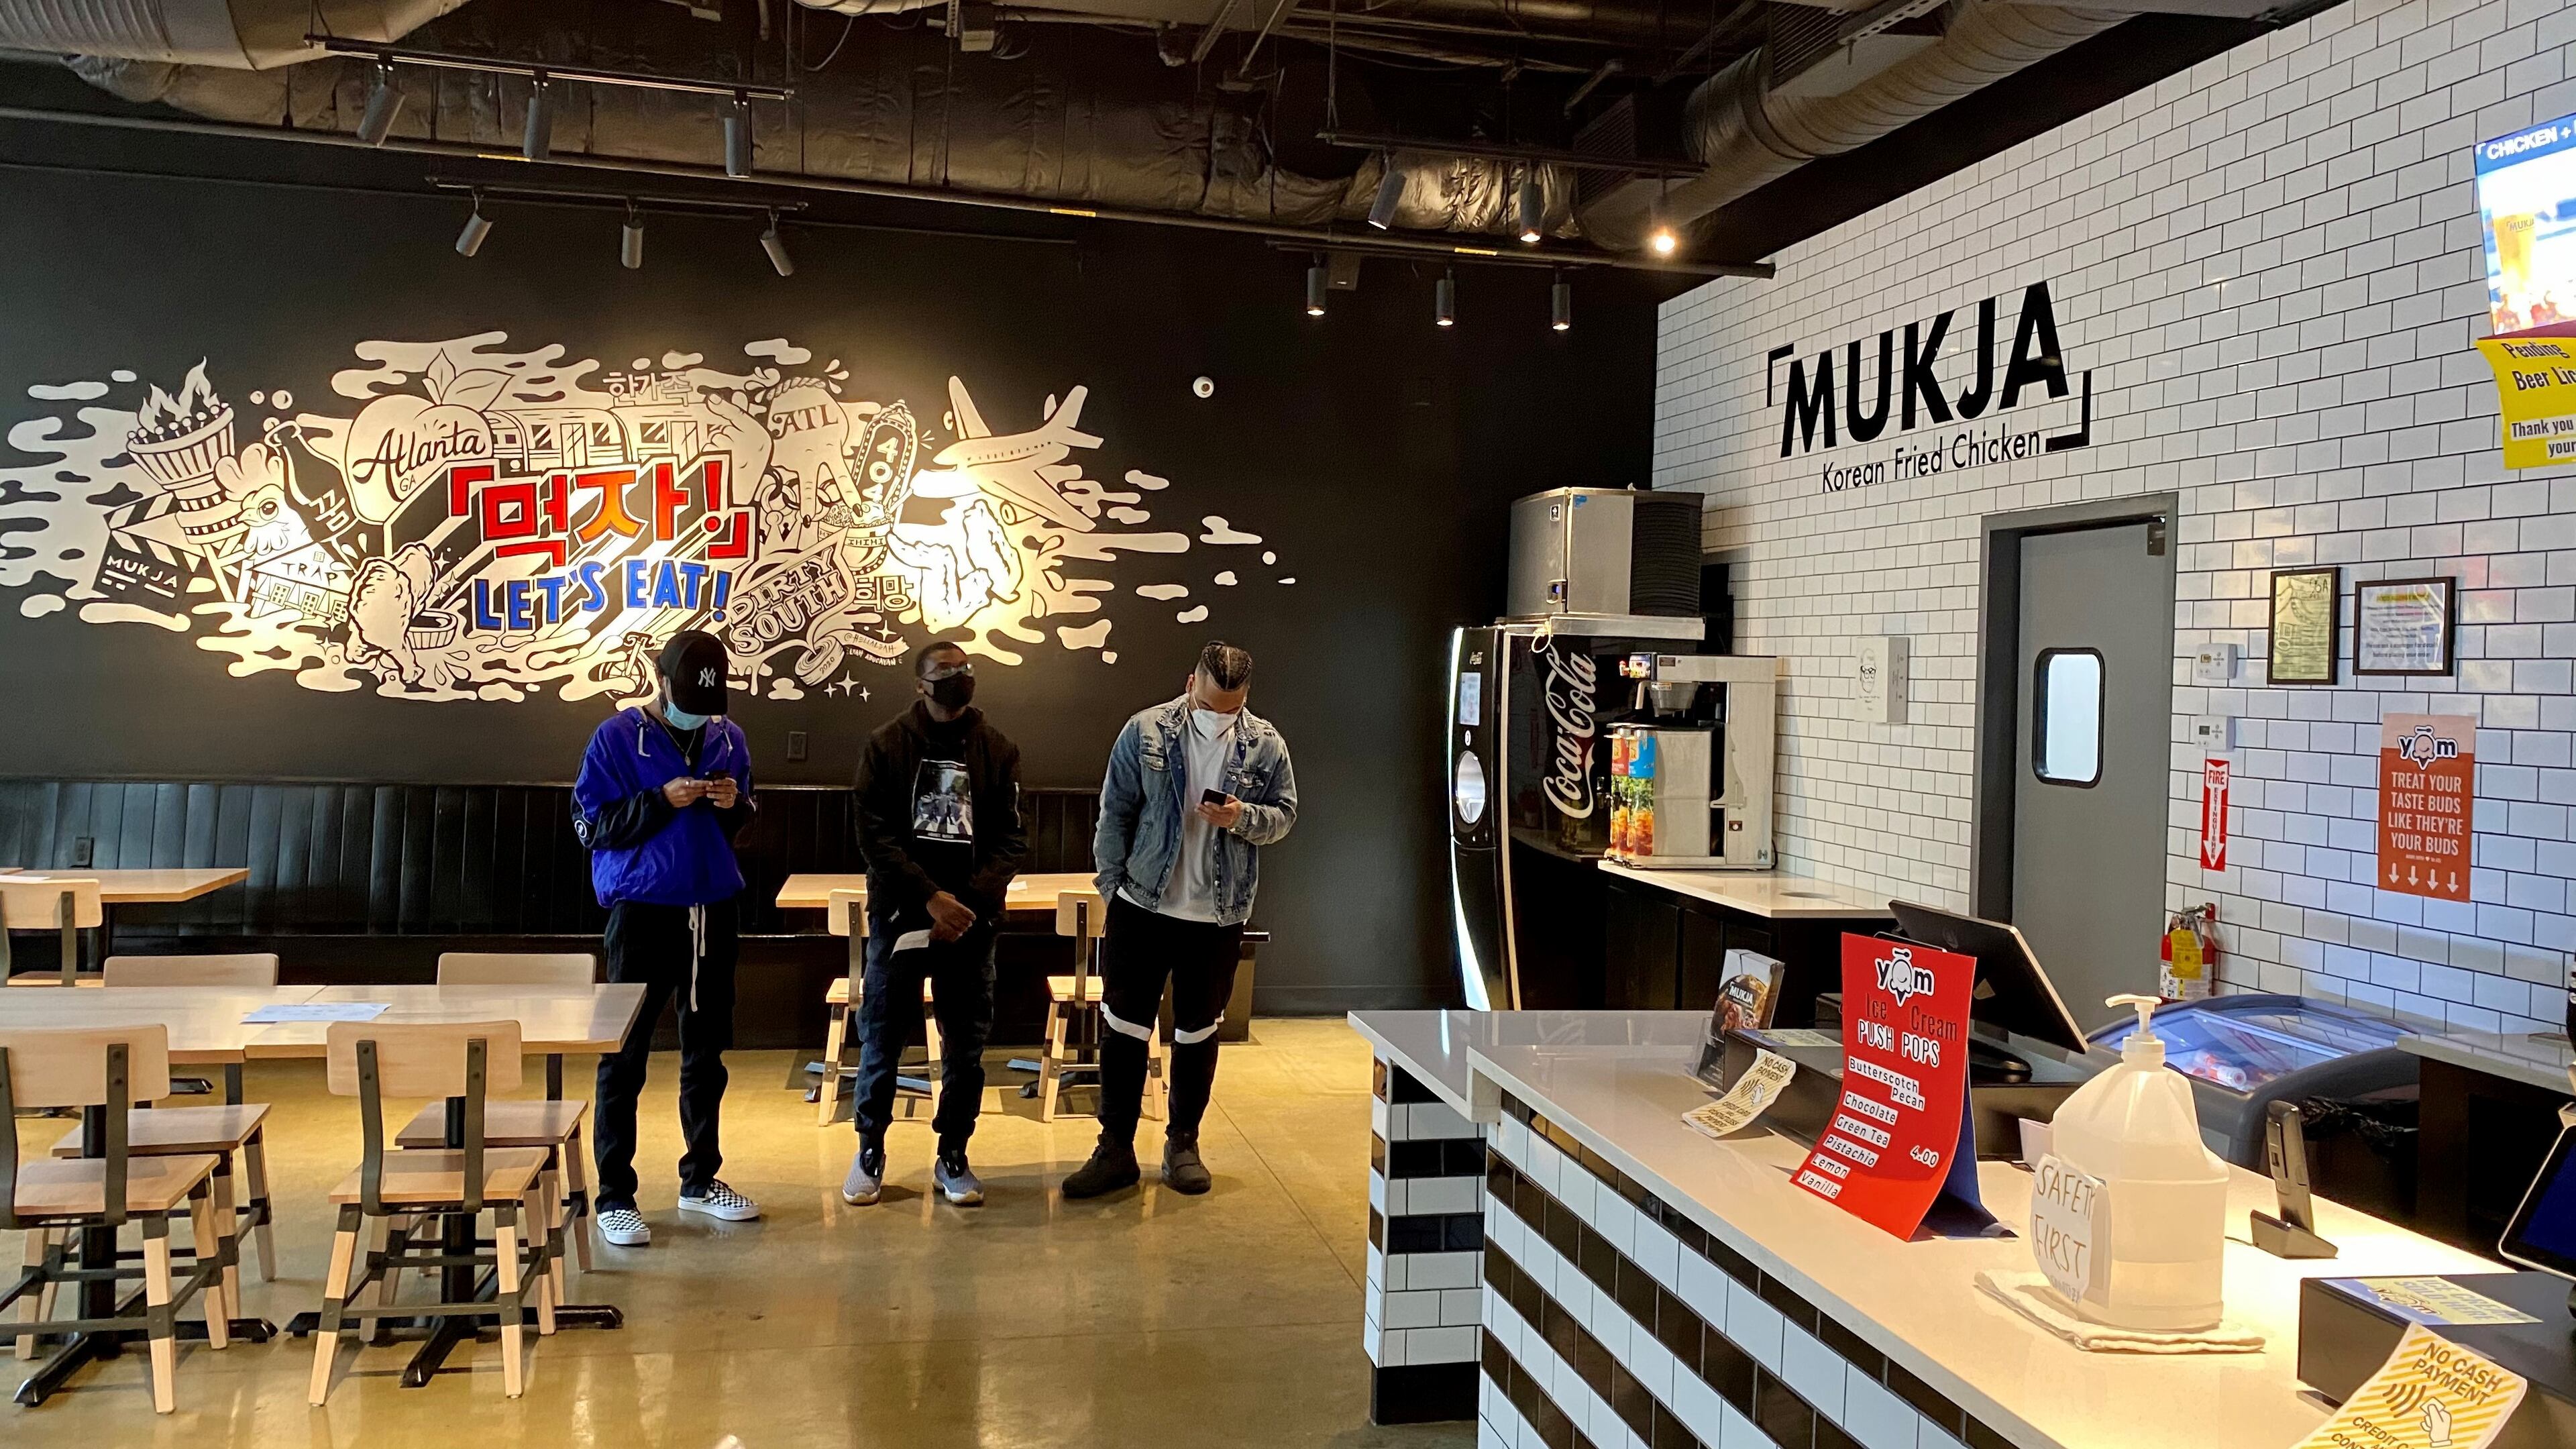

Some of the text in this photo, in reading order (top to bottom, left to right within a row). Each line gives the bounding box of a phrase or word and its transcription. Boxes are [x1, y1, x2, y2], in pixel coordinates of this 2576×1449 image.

[2487, 126, 2559, 160] CHICKEN
[2501, 342, 2571, 359] Pending
[1780, 280, 2070, 458] MUKJA
[2512, 370, 2551, 392] Beer
[602, 371, 693, 408] 한가족
[772, 403, 839, 440] ATL
[2512, 419, 2573, 437] Thank you
[352, 421, 486, 502] Atlanta
[1822, 423, 2041, 493] Korean Fried Chicken
[399, 474, 417, 492] GA
[107, 555, 178, 588] MUKJA
[281, 561, 339, 587] TRAP
[731, 547, 833, 625] DIRTY
[474, 559, 733, 630] LET'S EAT!
[853, 575, 914, 613] 희망
[731, 570, 847, 654] SOUTH
[698, 667, 716, 688] NY
[819, 656, 836, 674] 2020
[1543, 643, 1596, 819] Coca-Cola
[2208, 769, 2226, 785] FIRE
[2392, 771, 2462, 794] TREAT YOUR
[2391, 792, 2461, 814] TASTE BUDS
[2388, 812, 2463, 836] LIKE THEY'RE
[2391, 832, 2459, 856] YOUR BUDS
[1729, 985, 1754, 1005] MUKJA
[1866, 993, 1957, 1042] Ice Cream
[1859, 1020, 1894, 1051] PUSH
[1903, 1033, 1939, 1066] POPS
[1849, 1057, 1918, 1093] Butterscotch
[1845, 1093, 1896, 1123] Chocolate
[1892, 1087, 1924, 1110] Pecan
[1836, 1116, 1888, 1146] Green Tea
[1813, 1155, 1847, 1177] Lemon
[1825, 1136, 1875, 1167] Pistachio
[1912, 1146, 1937, 1166] 4.00
[1802, 1172, 1838, 1197] Vanilla
[2036, 1165, 2096, 1221] SAFETY
[2035, 1214, 2086, 1279] FIRST
[2412, 1358, 2493, 1407] PAYMENT
[2422, 1342, 2503, 1393] NO CASH
[2353, 1417, 2400, 1446] CREDIT
